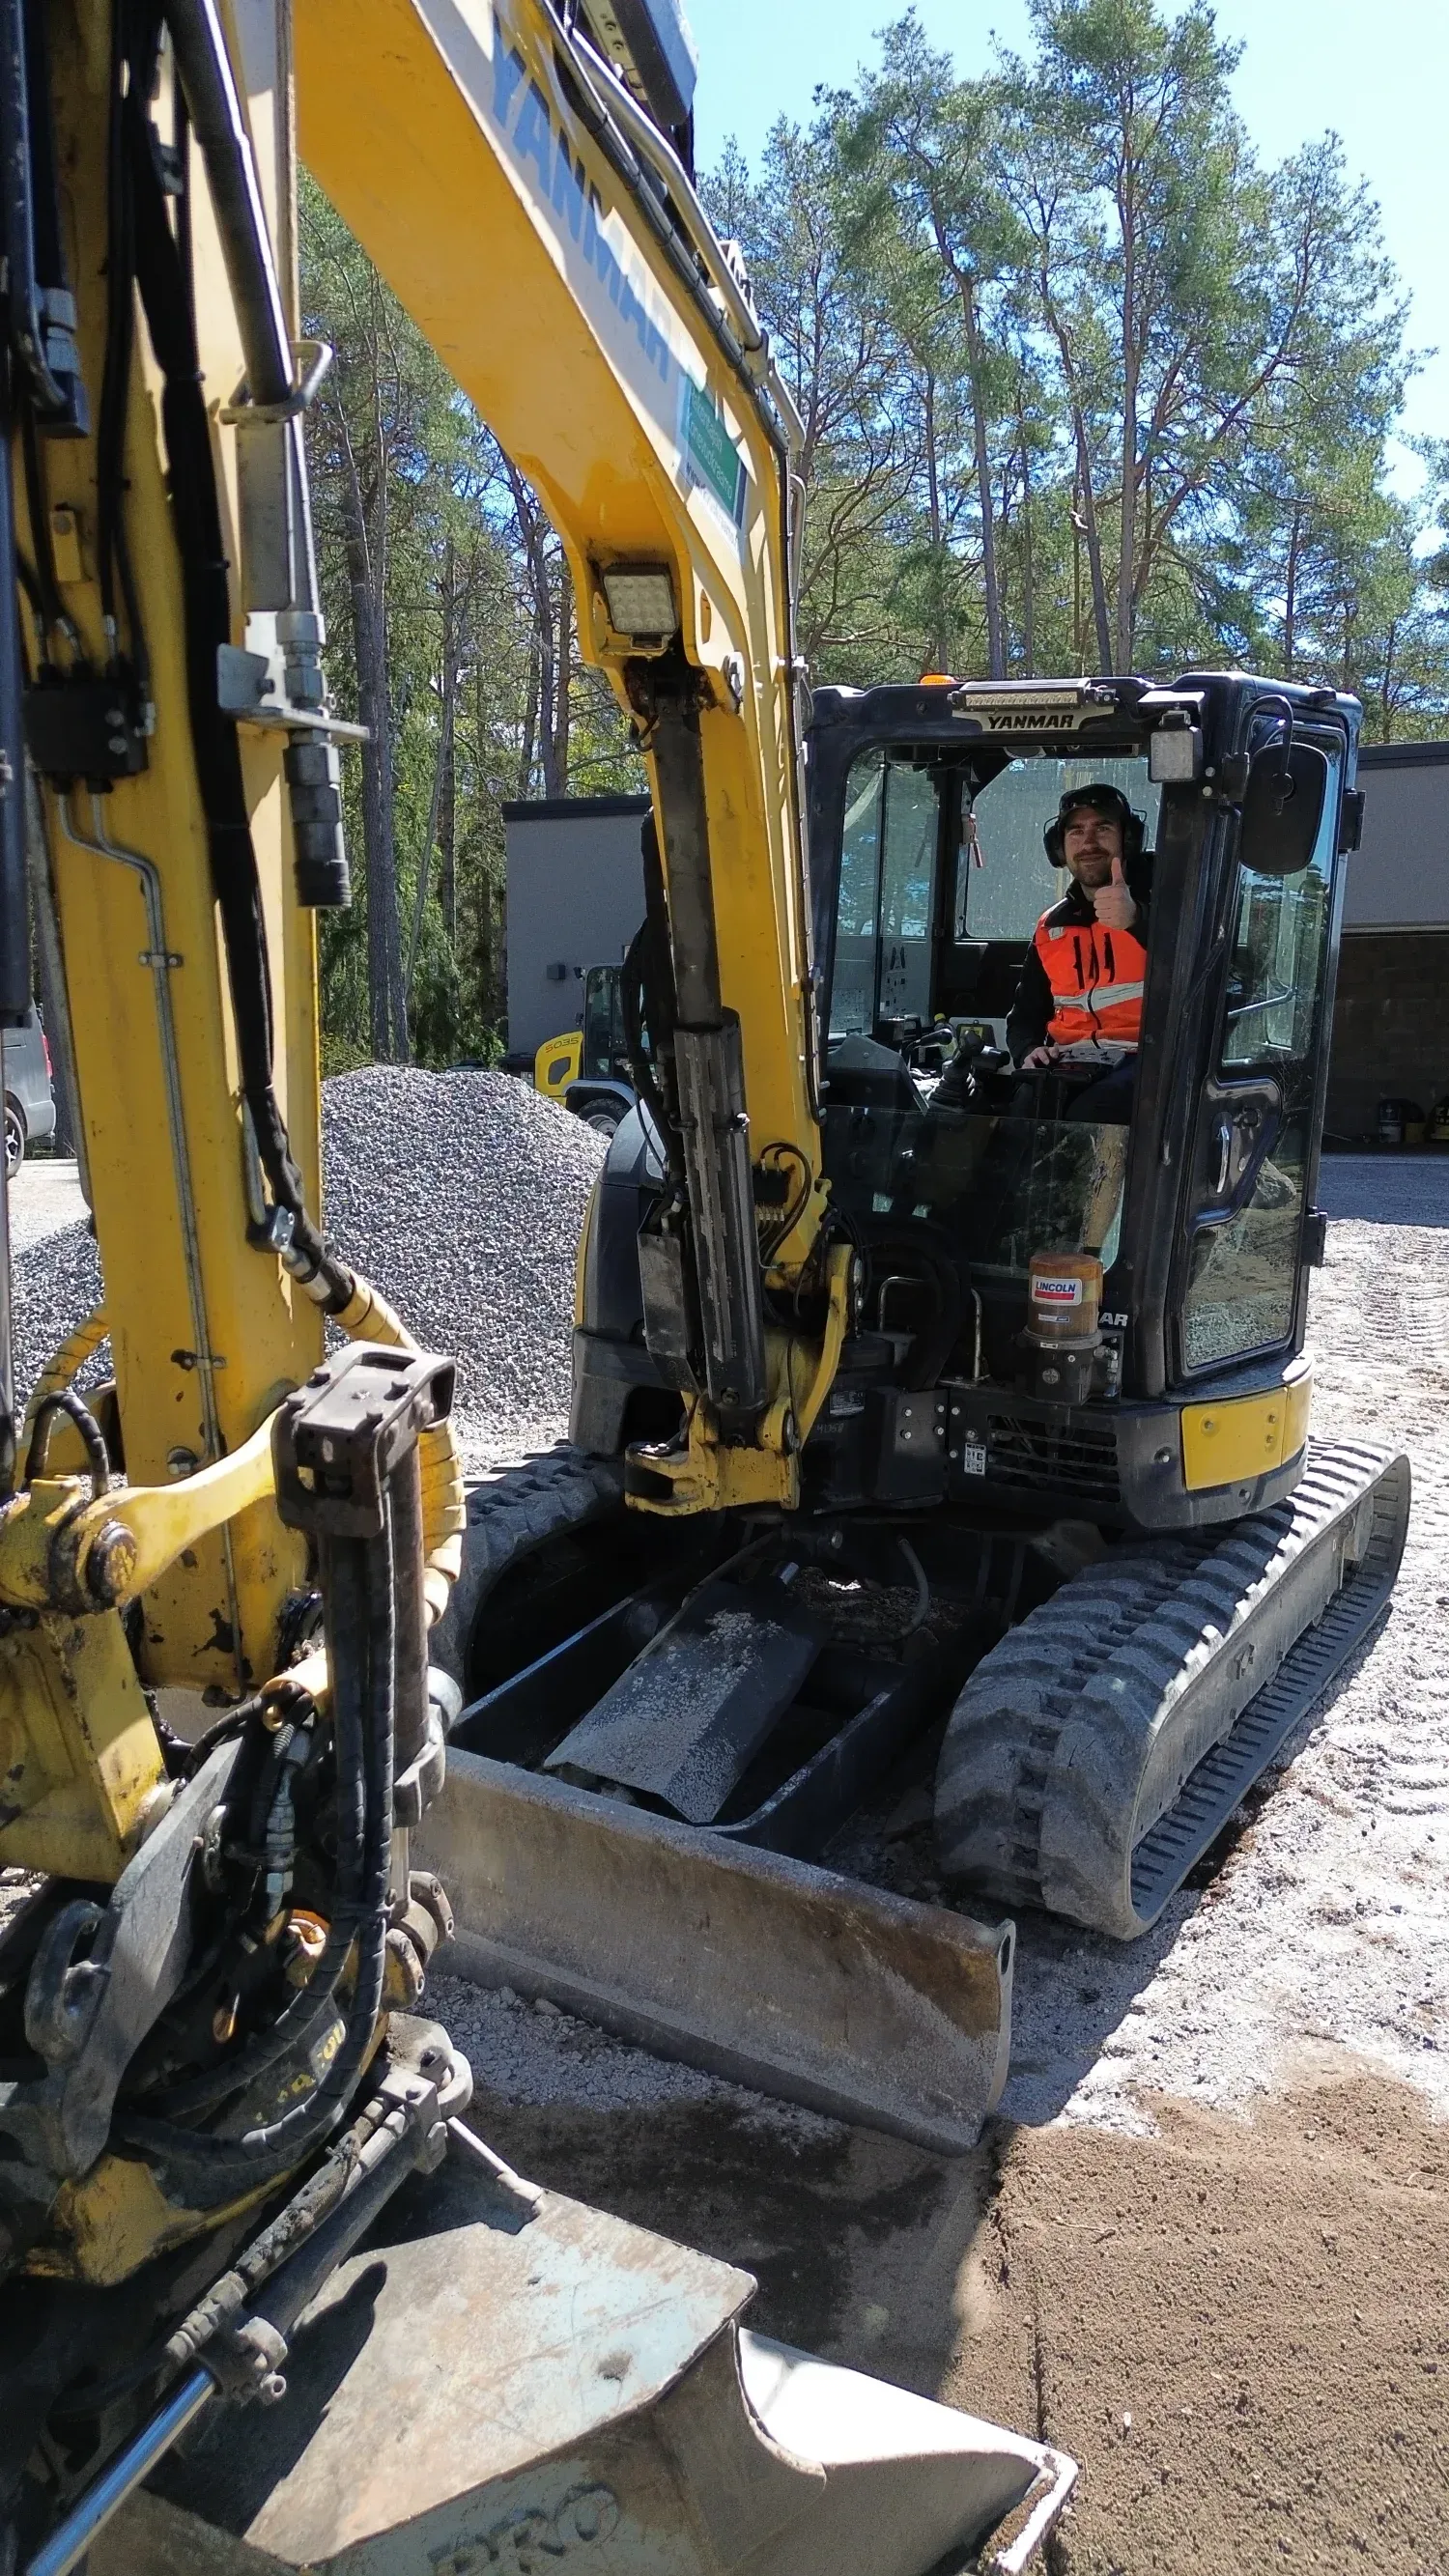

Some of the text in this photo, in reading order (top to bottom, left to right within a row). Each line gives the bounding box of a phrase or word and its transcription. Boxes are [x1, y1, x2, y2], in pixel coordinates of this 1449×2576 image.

[493, 14, 672, 383] YANMAR
[987, 715, 1074, 729] YANMAR
[545, 1036, 580, 1054] 5035
[1036, 1281, 1076, 1292] LINCOLN
[1097, 1312, 1128, 1327] AR
